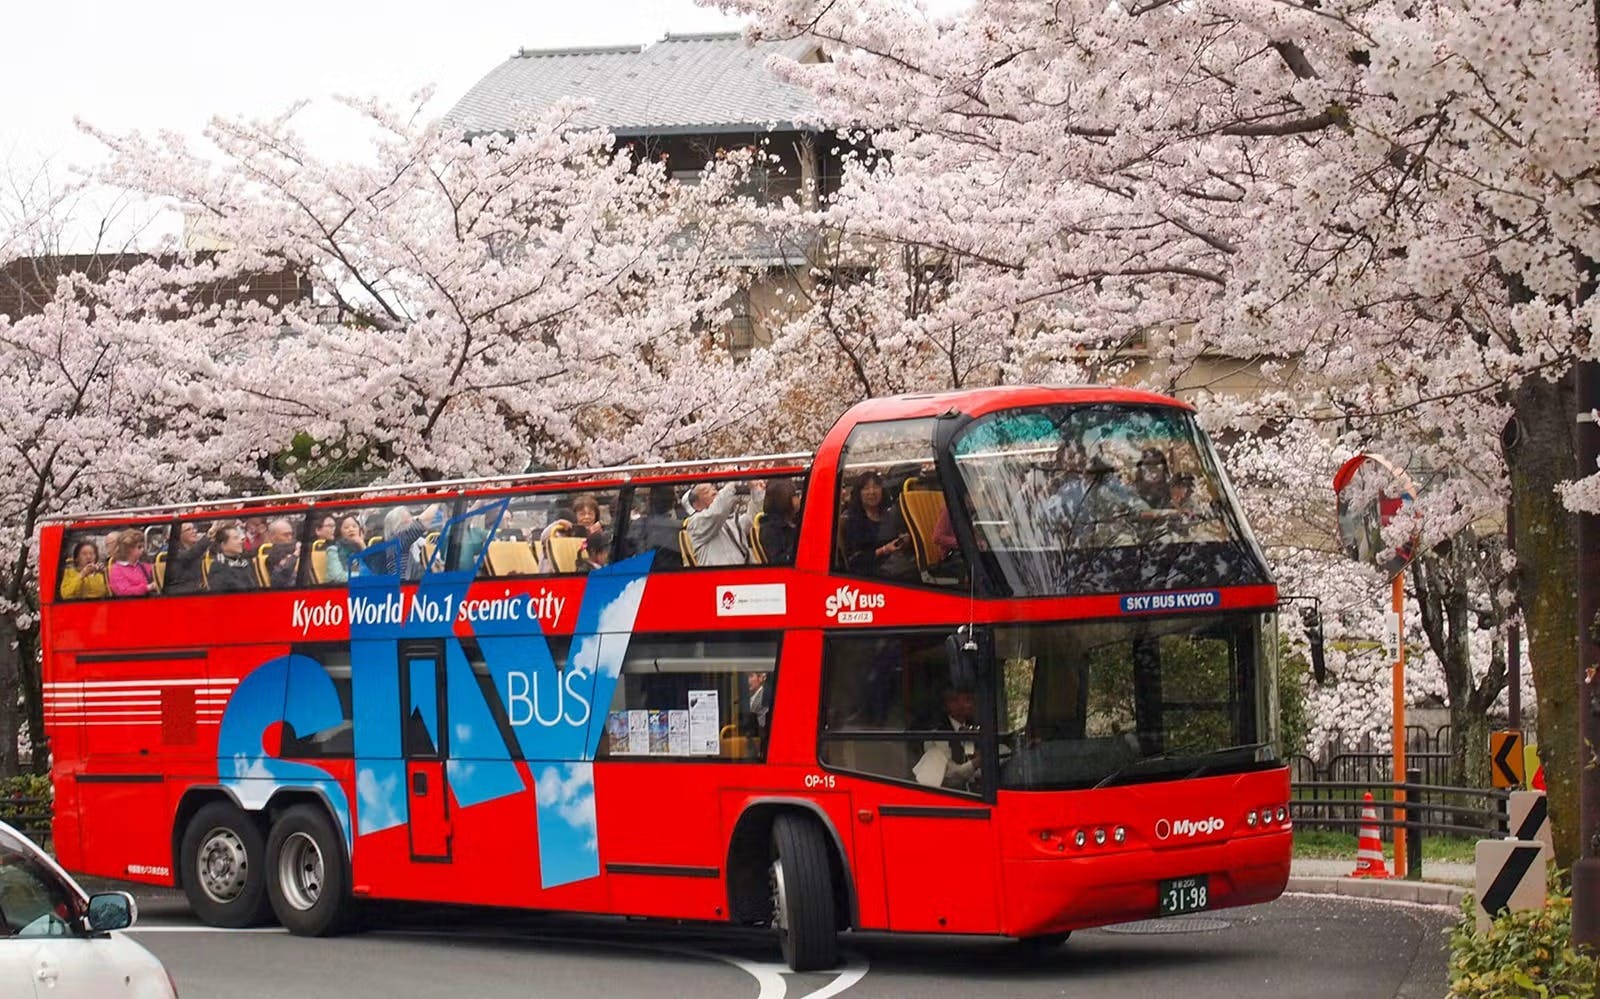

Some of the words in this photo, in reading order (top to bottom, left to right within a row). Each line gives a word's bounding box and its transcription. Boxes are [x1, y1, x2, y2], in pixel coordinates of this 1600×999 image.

[292, 599, 343, 636] Kyoto
[347, 593, 404, 625] World
[409, 594, 453, 623] No.1
[457, 588, 521, 622] scenic
[526, 587, 566, 628] city
[825, 585, 860, 617] SKY
[859, 593, 885, 608] BUS
[1126, 596, 1151, 611] SKY
[1152, 594, 1176, 608] BUS
[1176, 592, 1214, 607] KYOTO
[507, 669, 591, 727] BUS
[804, 774, 836, 788] OP-15
[1172, 816, 1225, 837] Myojo
